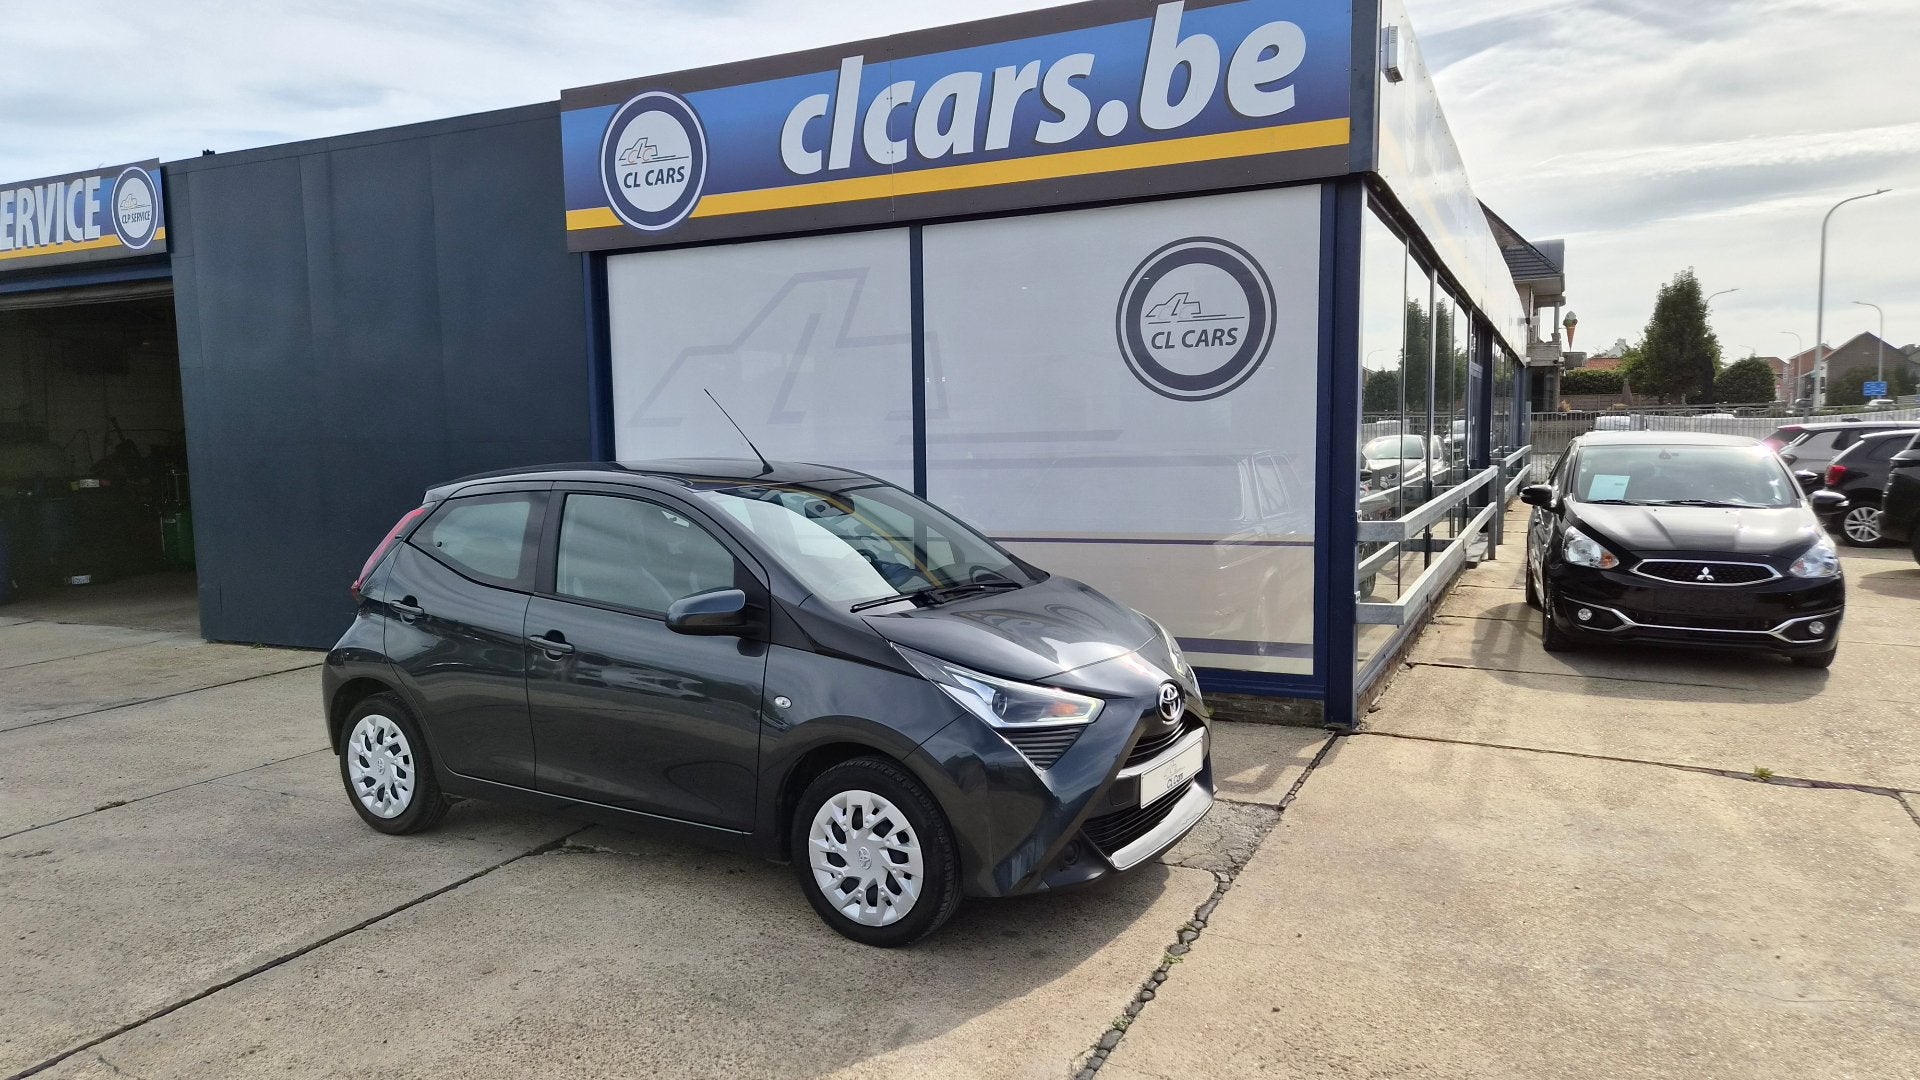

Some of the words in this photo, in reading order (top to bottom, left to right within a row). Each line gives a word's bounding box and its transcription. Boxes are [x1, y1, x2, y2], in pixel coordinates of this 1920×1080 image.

[779, 0, 1308, 175] clcars.be
[623, 172, 641, 189] CL
[645, 166, 685, 187] CARS
[131, 211, 150, 223] SERVICE
[1151, 331, 1175, 349] CL
[1181, 327, 1238, 348] CARS
